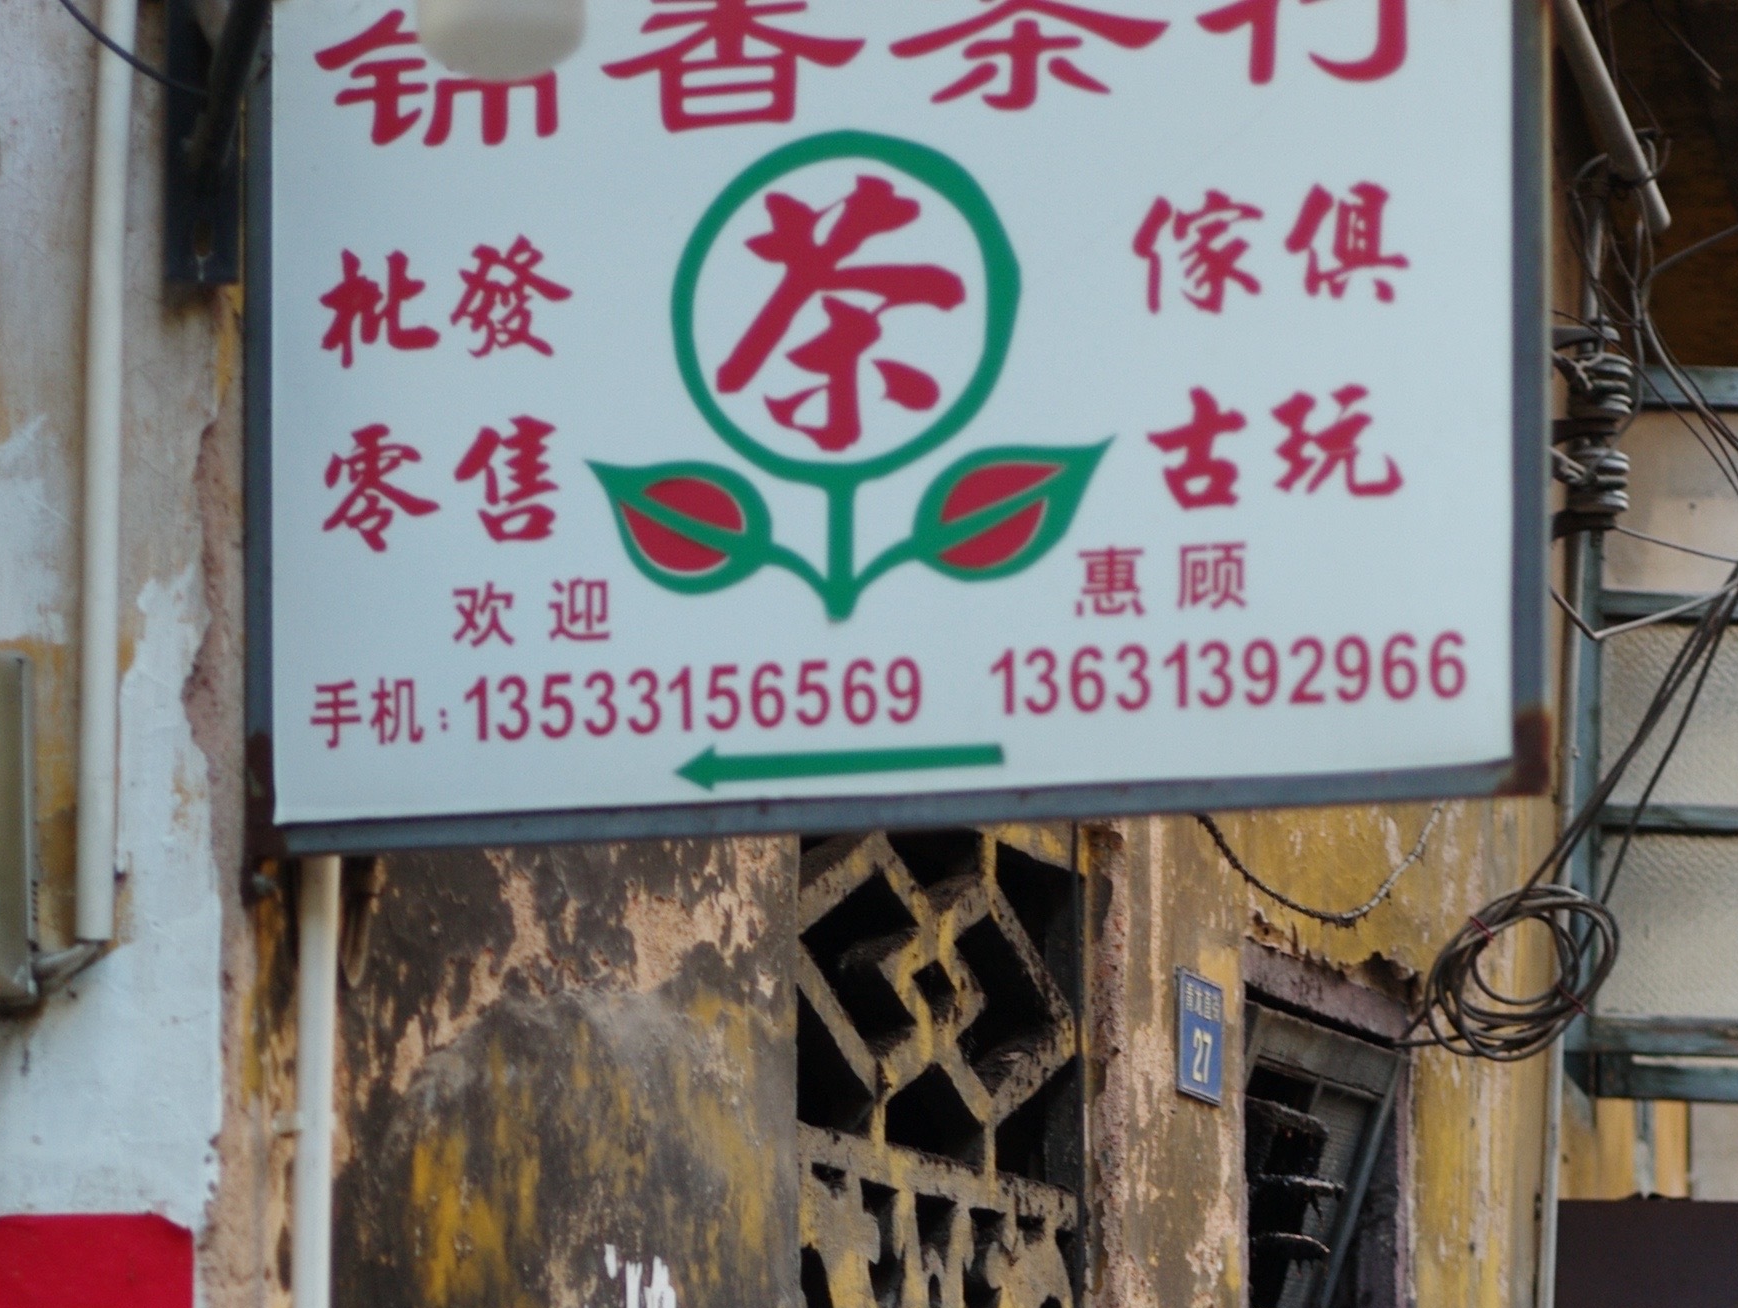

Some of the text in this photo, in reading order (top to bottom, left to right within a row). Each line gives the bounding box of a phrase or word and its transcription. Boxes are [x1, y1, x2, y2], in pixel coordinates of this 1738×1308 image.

[320, 236, 572, 368] 批發
[1133, 182, 1409, 314] 傢俱
[716, 175, 967, 453] 茶
[323, 416, 557, 552] 零售
[1147, 384, 1403, 510] 古玩
[452, 543, 1245, 647] 欢迎 惠顾
[989, 631, 1466, 715] 13631392966
[1192, 1027, 1214, 1085] 27
